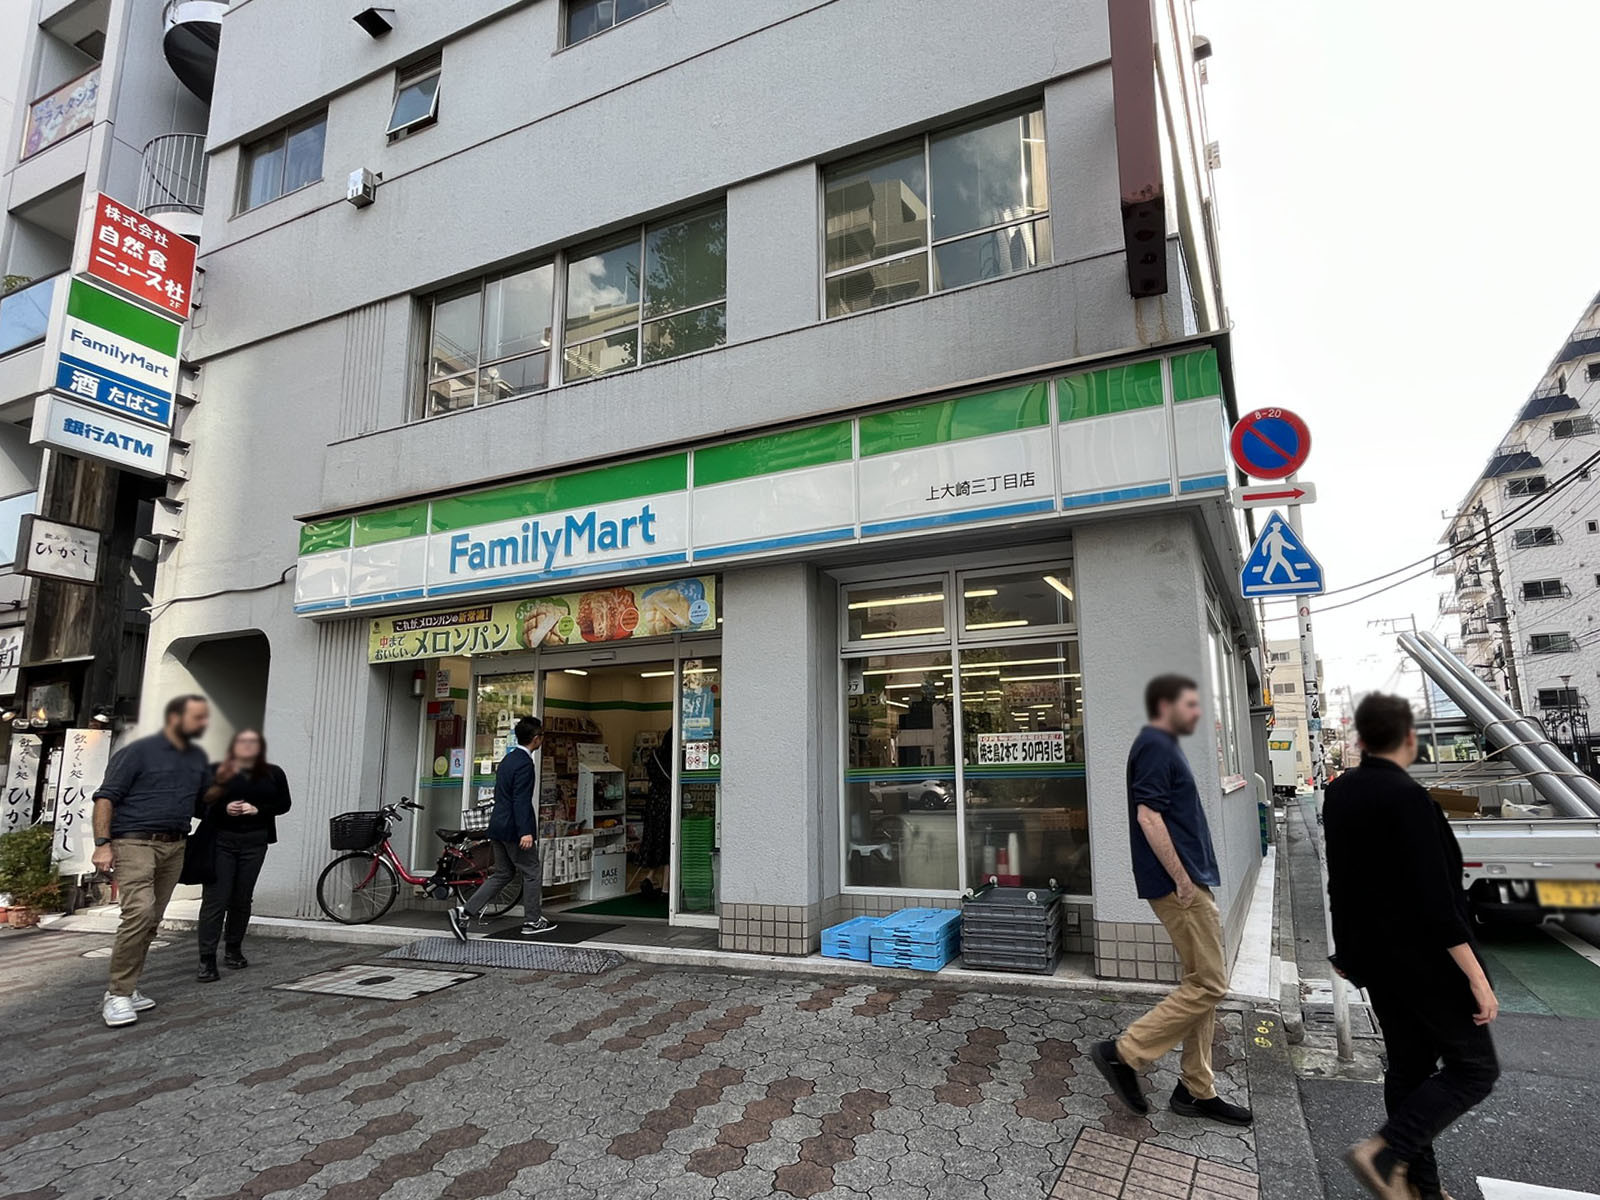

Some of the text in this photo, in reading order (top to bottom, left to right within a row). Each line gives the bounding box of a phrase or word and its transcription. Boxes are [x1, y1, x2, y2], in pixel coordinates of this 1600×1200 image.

[104, 203, 169, 248] 株式会社
[98, 224, 168, 272] 自然食
[95, 247, 185, 303] ニュース社
[169, 300, 181, 309] 2F
[70, 328, 169, 378] FamilyMart
[69, 369, 159, 417] 酒 たばこ
[1254, 409, 1282, 420] 8-20
[63, 417, 154, 458] 銀行ATM
[925, 471, 1036, 501] 上大崎三丁目店
[35, 542, 90, 566] ひがし
[449, 504, 656, 574] FamilyMart
[375, 647, 409, 660] おいしい
[380, 634, 406, 648] 中まで
[411, 624, 510, 657] メロンパン
[1021, 741, 1063, 761] 50円引き
[6, 787, 32, 832] ひが
[61, 786, 86, 853] ひがし
[601, 868, 618, 878] BASE
